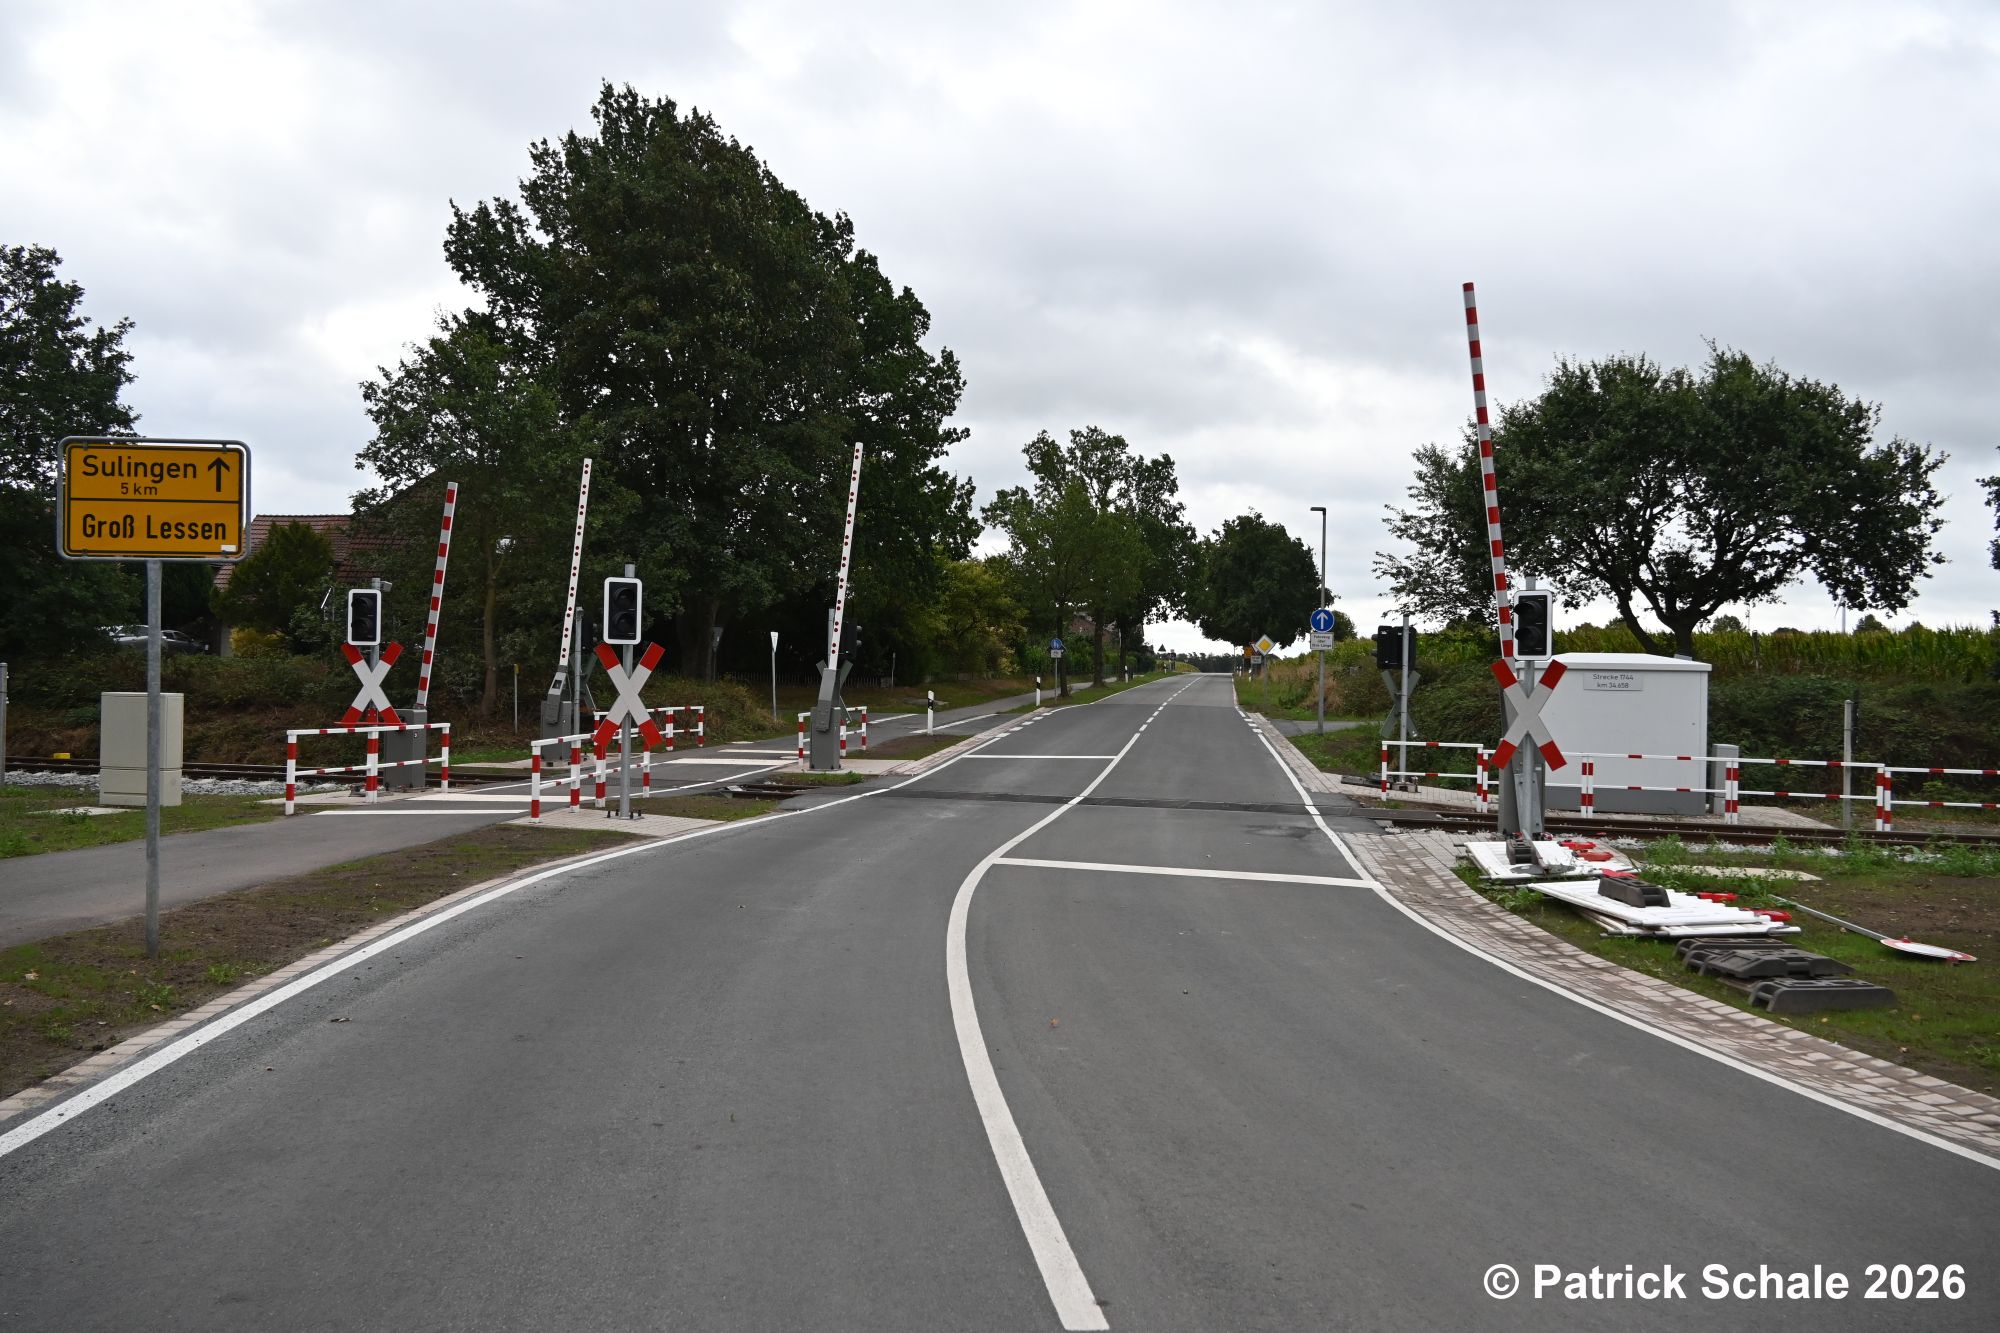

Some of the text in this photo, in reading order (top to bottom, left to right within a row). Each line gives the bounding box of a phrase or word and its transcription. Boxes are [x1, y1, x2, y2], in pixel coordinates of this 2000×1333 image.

[82, 455, 197, 484] Sulingen
[120, 482, 158, 496] 5 km
[82, 513, 227, 541] Groß Lessen
